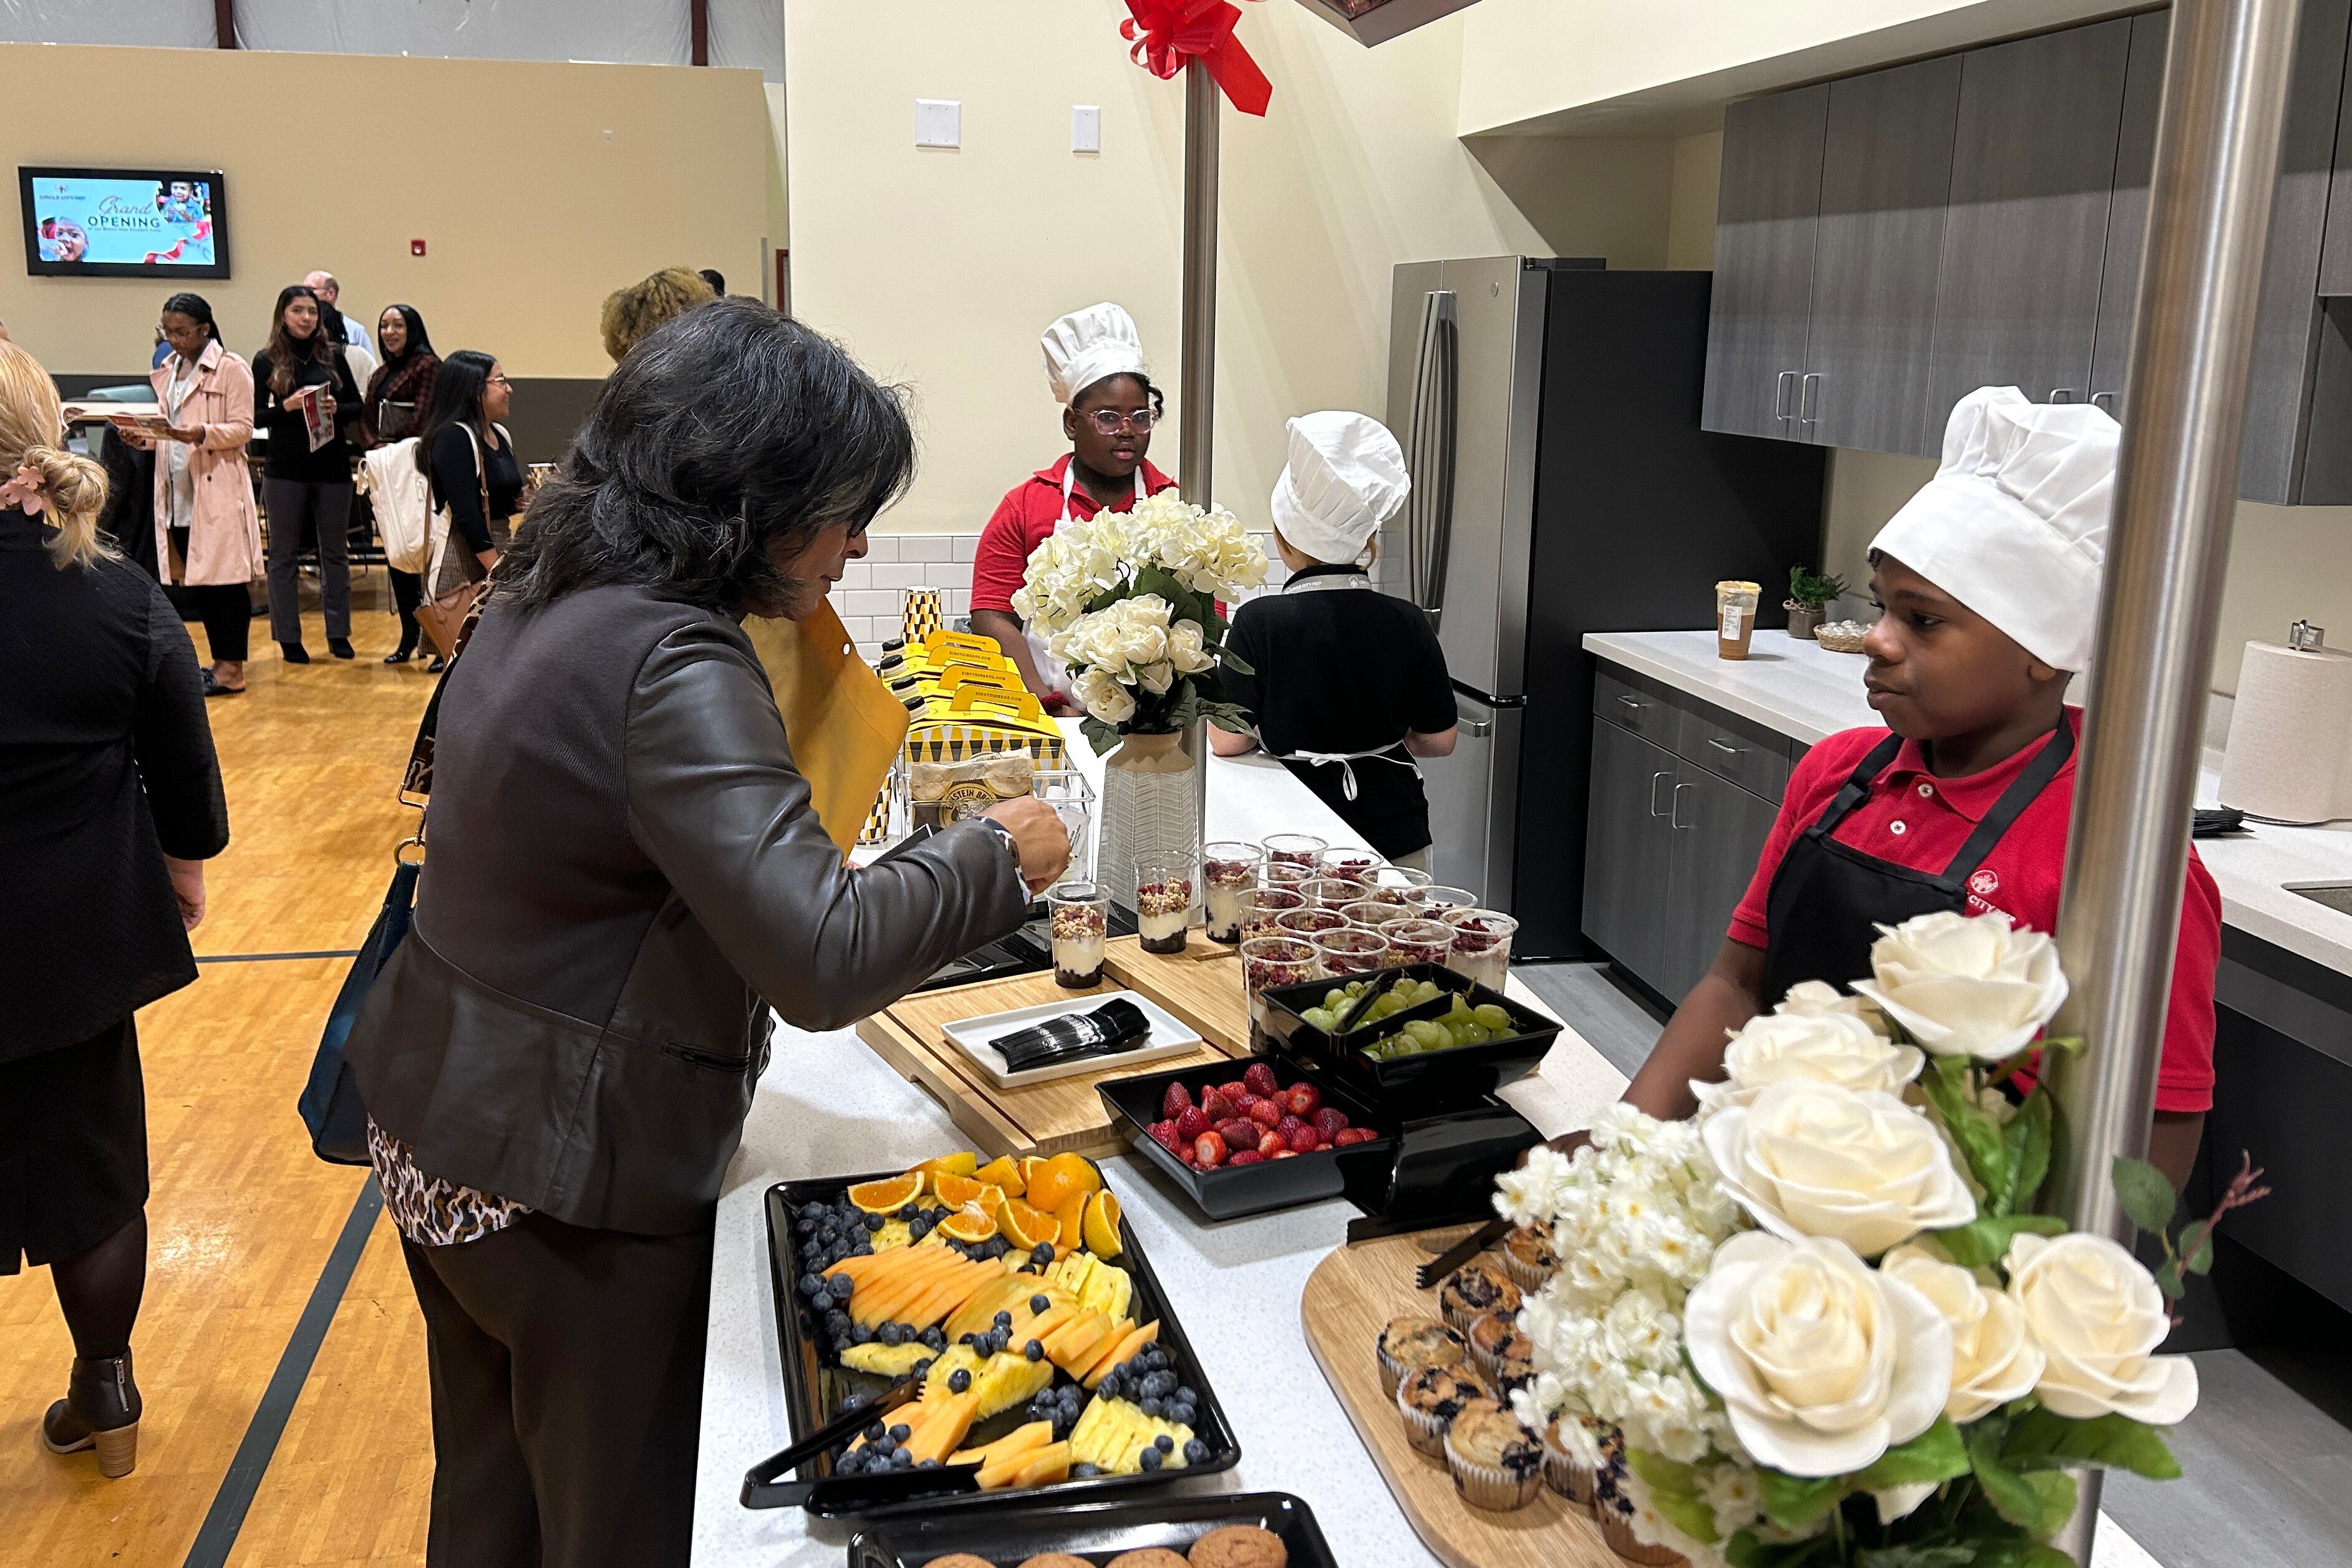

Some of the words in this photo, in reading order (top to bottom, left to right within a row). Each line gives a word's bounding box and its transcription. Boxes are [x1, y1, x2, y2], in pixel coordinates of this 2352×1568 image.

[99, 195, 153, 215] Grand
[88, 216, 160, 228] OPENING
[962, 671, 1006, 680] EINSTEINBROS.COM
[975, 691, 1022, 702] EINSTEINBROS.COM
[946, 789, 974, 810] ESTEIN
[1968, 895, 1995, 913] CITY
